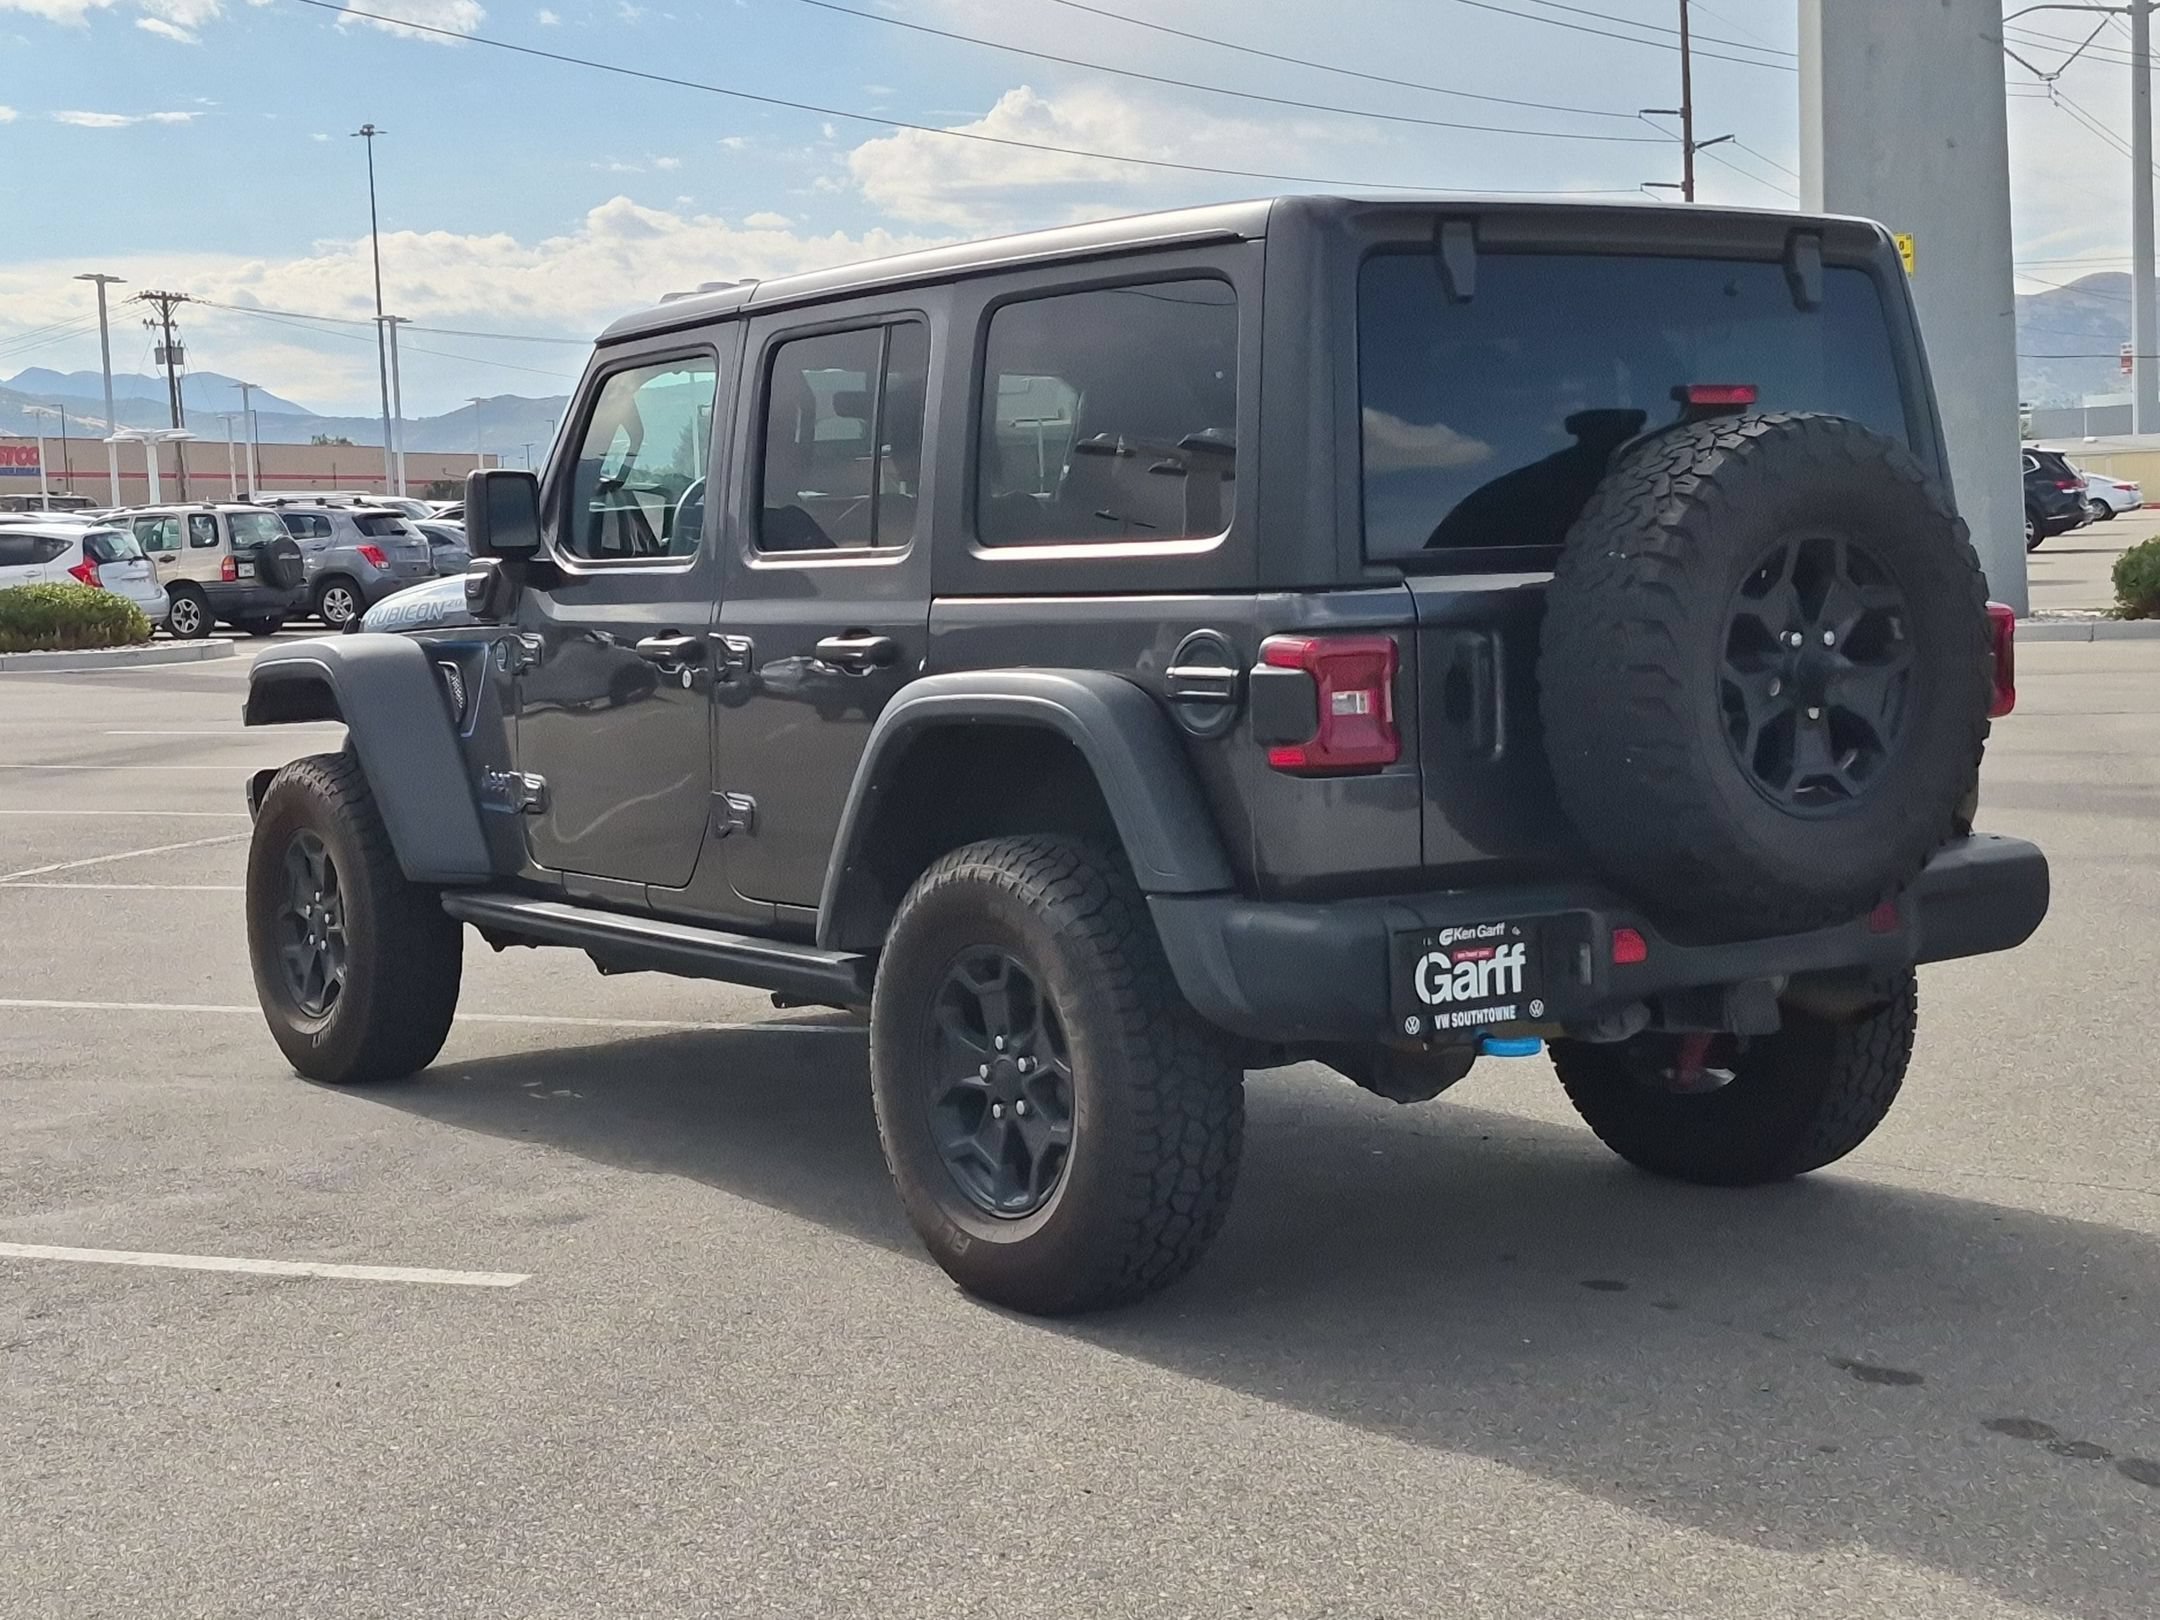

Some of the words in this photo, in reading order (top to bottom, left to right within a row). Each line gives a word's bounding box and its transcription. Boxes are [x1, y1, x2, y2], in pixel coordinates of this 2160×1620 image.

[368, 601, 445, 627] RUBICON
[1453, 927, 1476, 941] Ken
[1477, 922, 1506, 938] Garff
[1414, 943, 1526, 1004] Garff
[1434, 1012, 1450, 1030] VW
[1451, 1005, 1517, 1028] SOUTHTOWNE
